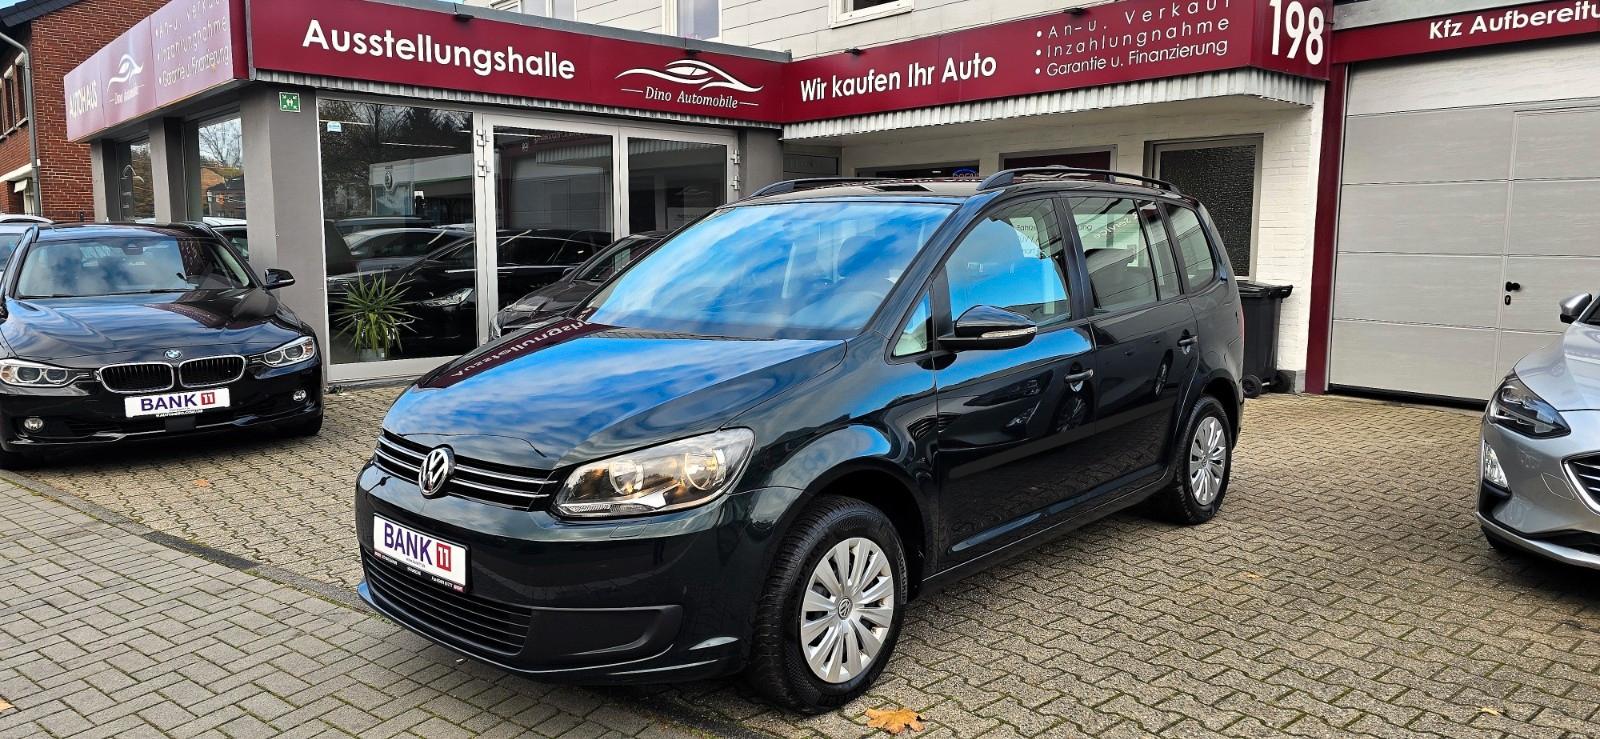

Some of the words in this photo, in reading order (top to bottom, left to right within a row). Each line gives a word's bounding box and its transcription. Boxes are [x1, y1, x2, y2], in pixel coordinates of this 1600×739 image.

[1047, 18, 1229, 58] Inzahlungnahme
[1269, 0, 1324, 65] 198
[1429, 19, 1462, 39] Kfz
[302, 19, 576, 80] Ausstellungshalle
[1047, 56, 1107, 76] Garantie
[1111, 56, 1123, 68] u.
[1128, 40, 1228, 65] Finanzierung
[645, 86, 672, 101] Dino
[677, 90, 738, 108] Automobile
[800, 78, 827, 102] Wir
[832, 69, 901, 98] kaufen
[908, 62, 936, 88] Ihr
[941, 52, 997, 83] Auto
[140, 394, 198, 412] BANK
[384, 522, 433, 566] BANK
[437, 544, 450, 570] 11
